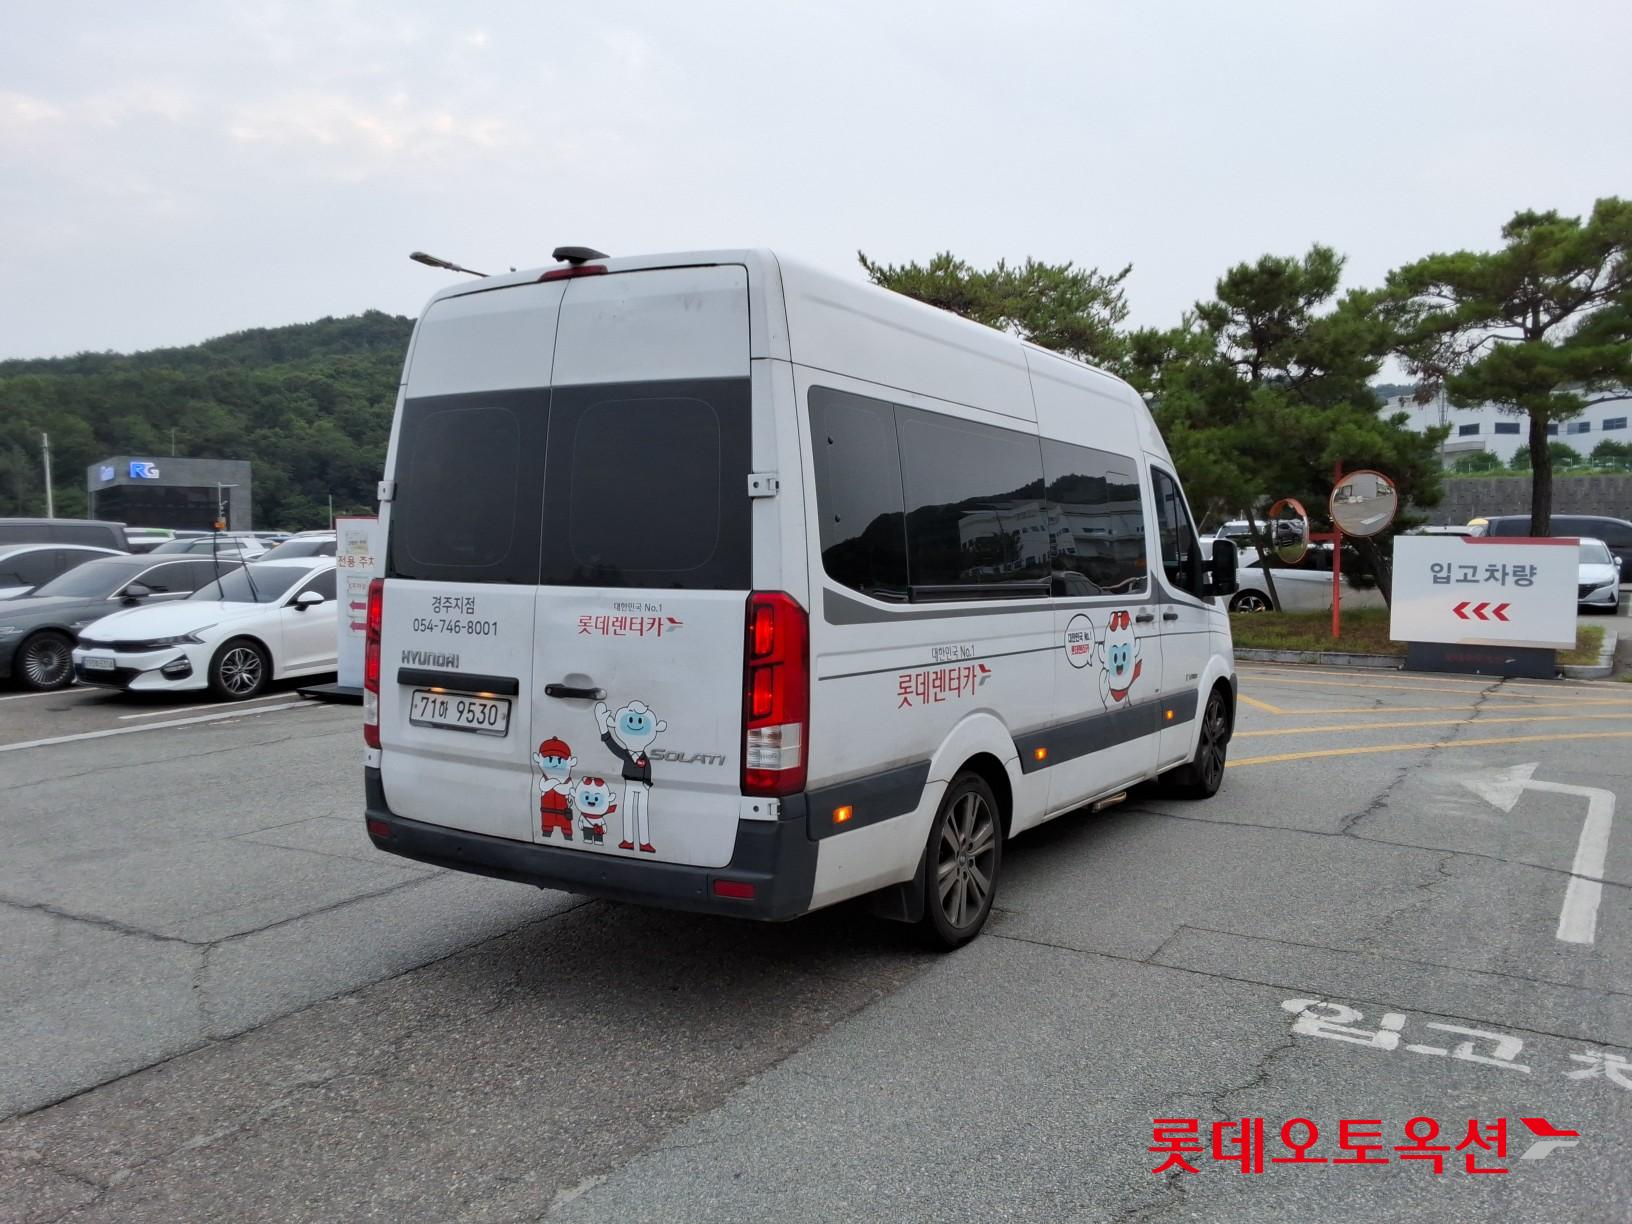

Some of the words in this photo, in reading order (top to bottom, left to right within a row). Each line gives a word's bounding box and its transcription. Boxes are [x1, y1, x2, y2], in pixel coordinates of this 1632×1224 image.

[1430, 562, 1537, 587] 입고차량
[432, 596, 475, 615] 경주지점
[613, 602, 642, 612] 대한민국
[644, 603, 662, 613] No.1
[413, 618, 498, 636] 054-746-8001
[578, 615, 664, 637] 롯데렌터카
[401, 650, 460, 669] HYUNDAI
[960, 645, 976, 658] No.1
[897, 664, 977, 710] 롯데렌터카
[420, 696, 448, 719] 71하
[456, 700, 498, 726] 9530
[649, 748, 726, 766] SOLATI
